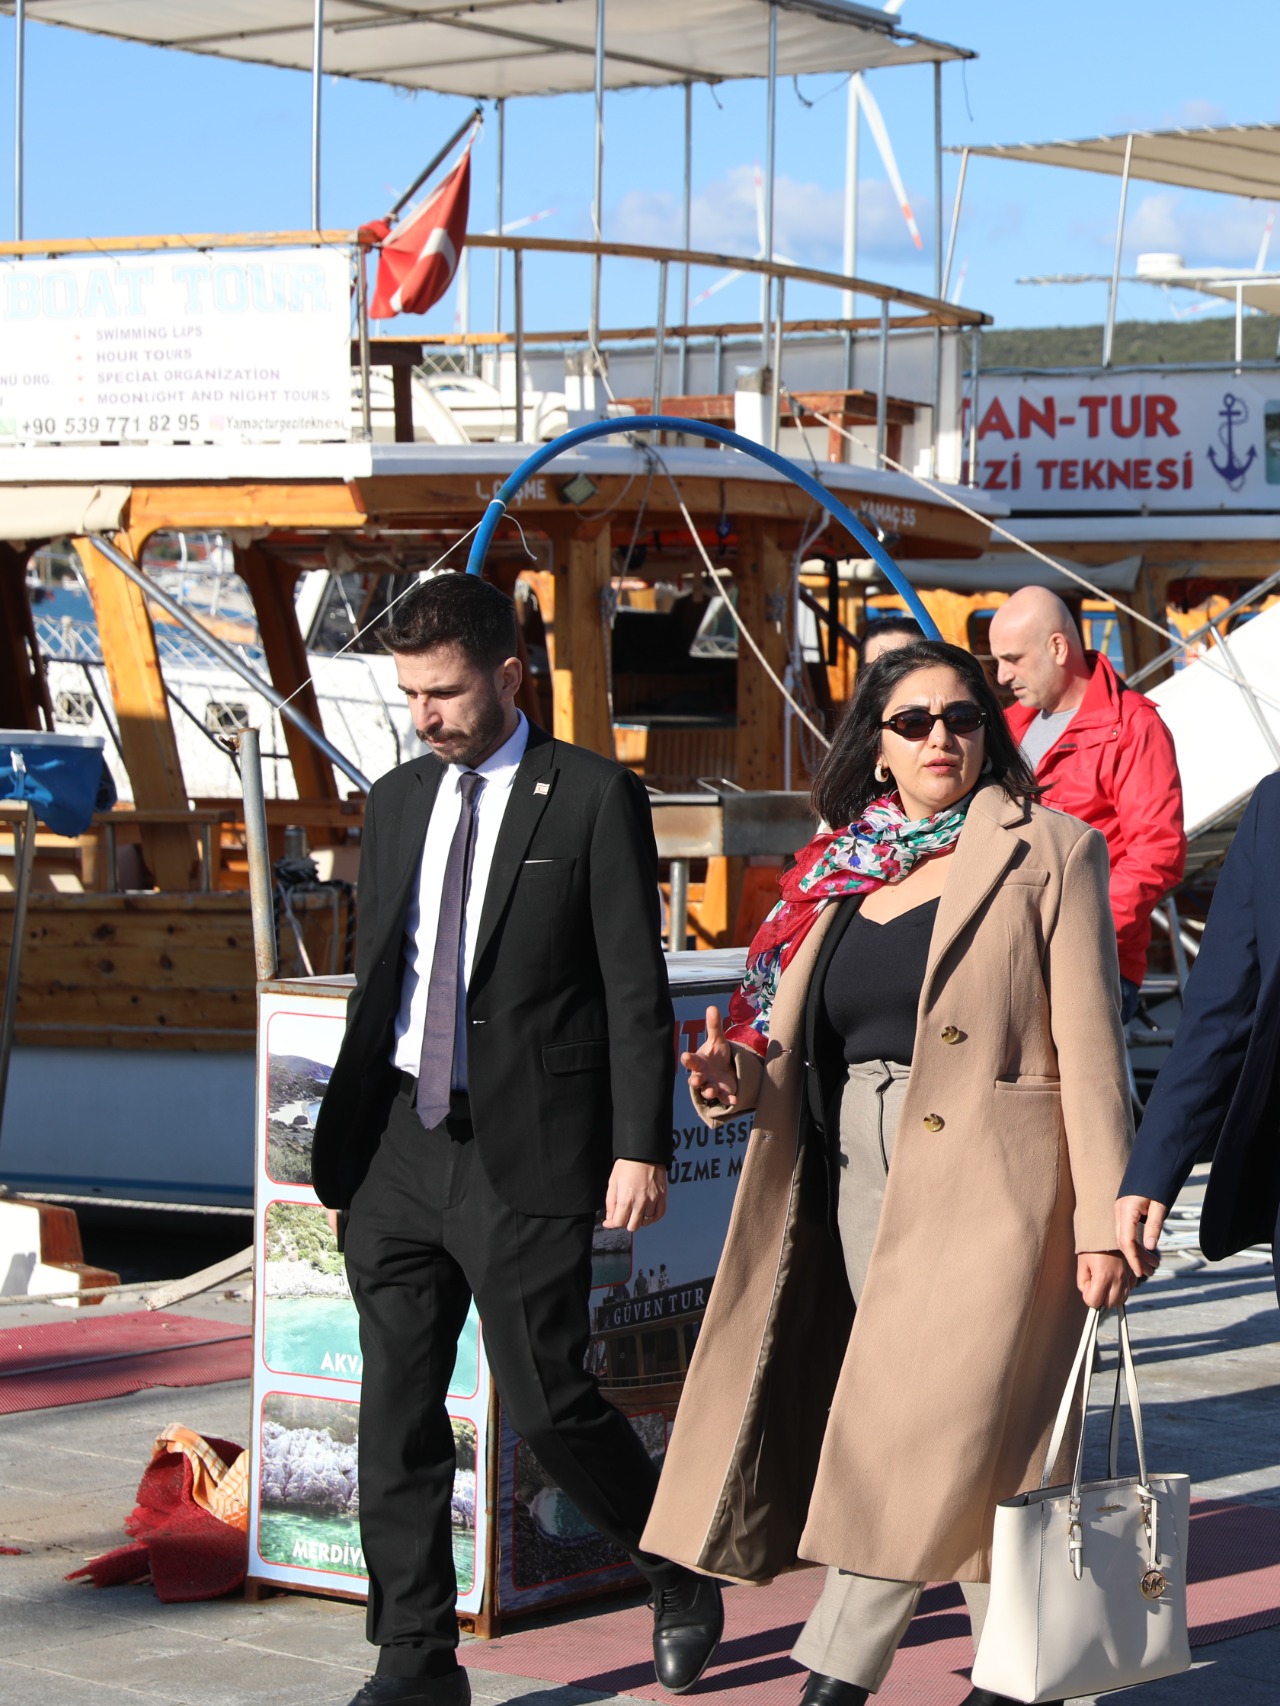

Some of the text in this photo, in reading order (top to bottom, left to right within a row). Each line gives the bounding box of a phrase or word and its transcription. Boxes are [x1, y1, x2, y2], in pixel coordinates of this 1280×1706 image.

[3, 262, 332, 321] BOAT TOUR
[96, 347, 193, 364] HOUR TOURS
[191, 389, 224, 403] AND
[283, 388, 332, 403] TOURS
[21, 416, 56, 436] +90
[64, 417, 100, 435] 539
[106, 415, 141, 436] 771
[148, 413, 172, 432] 82
[178, 413, 201, 431] 95
[1036, 450, 1193, 490] TEKNESİ
[614, 1287, 705, 1325] GÜVEN TUR
[320, 1351, 363, 1375] AKV
